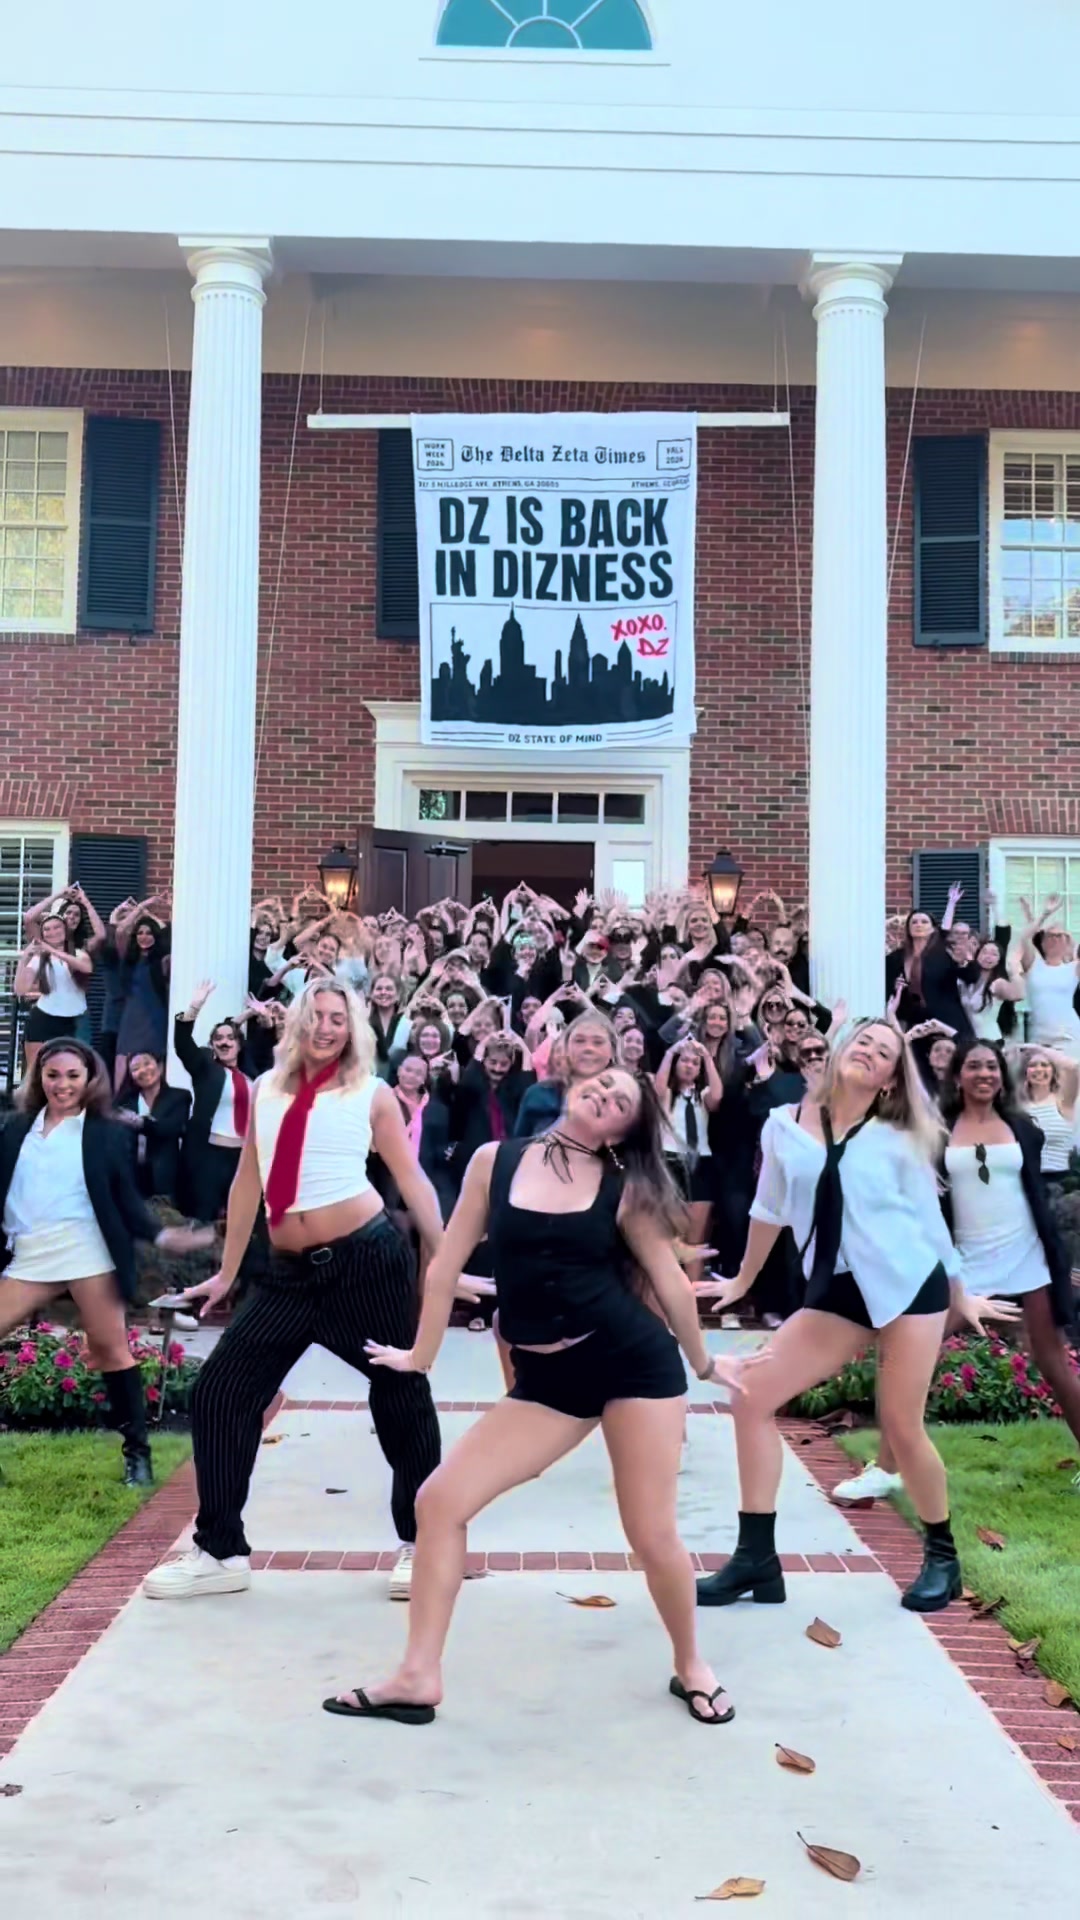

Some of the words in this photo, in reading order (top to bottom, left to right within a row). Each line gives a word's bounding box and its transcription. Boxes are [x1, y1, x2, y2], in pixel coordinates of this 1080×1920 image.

[461, 446, 493, 465] The
[500, 445, 545, 463] Delta
[552, 445, 589, 463] Zeta
[595, 446, 646, 464] Times
[439, 497, 490, 545] DZ
[506, 496, 543, 545] IS
[560, 497, 669, 548] BACK
[435, 549, 476, 597] IN
[493, 549, 673, 602] DIZNESS
[637, 637, 669, 657] DZ
[508, 733, 521, 743] DZ
[524, 734, 556, 744] STATE
[559, 734, 573, 743] OF
[575, 733, 603, 743] MIND
